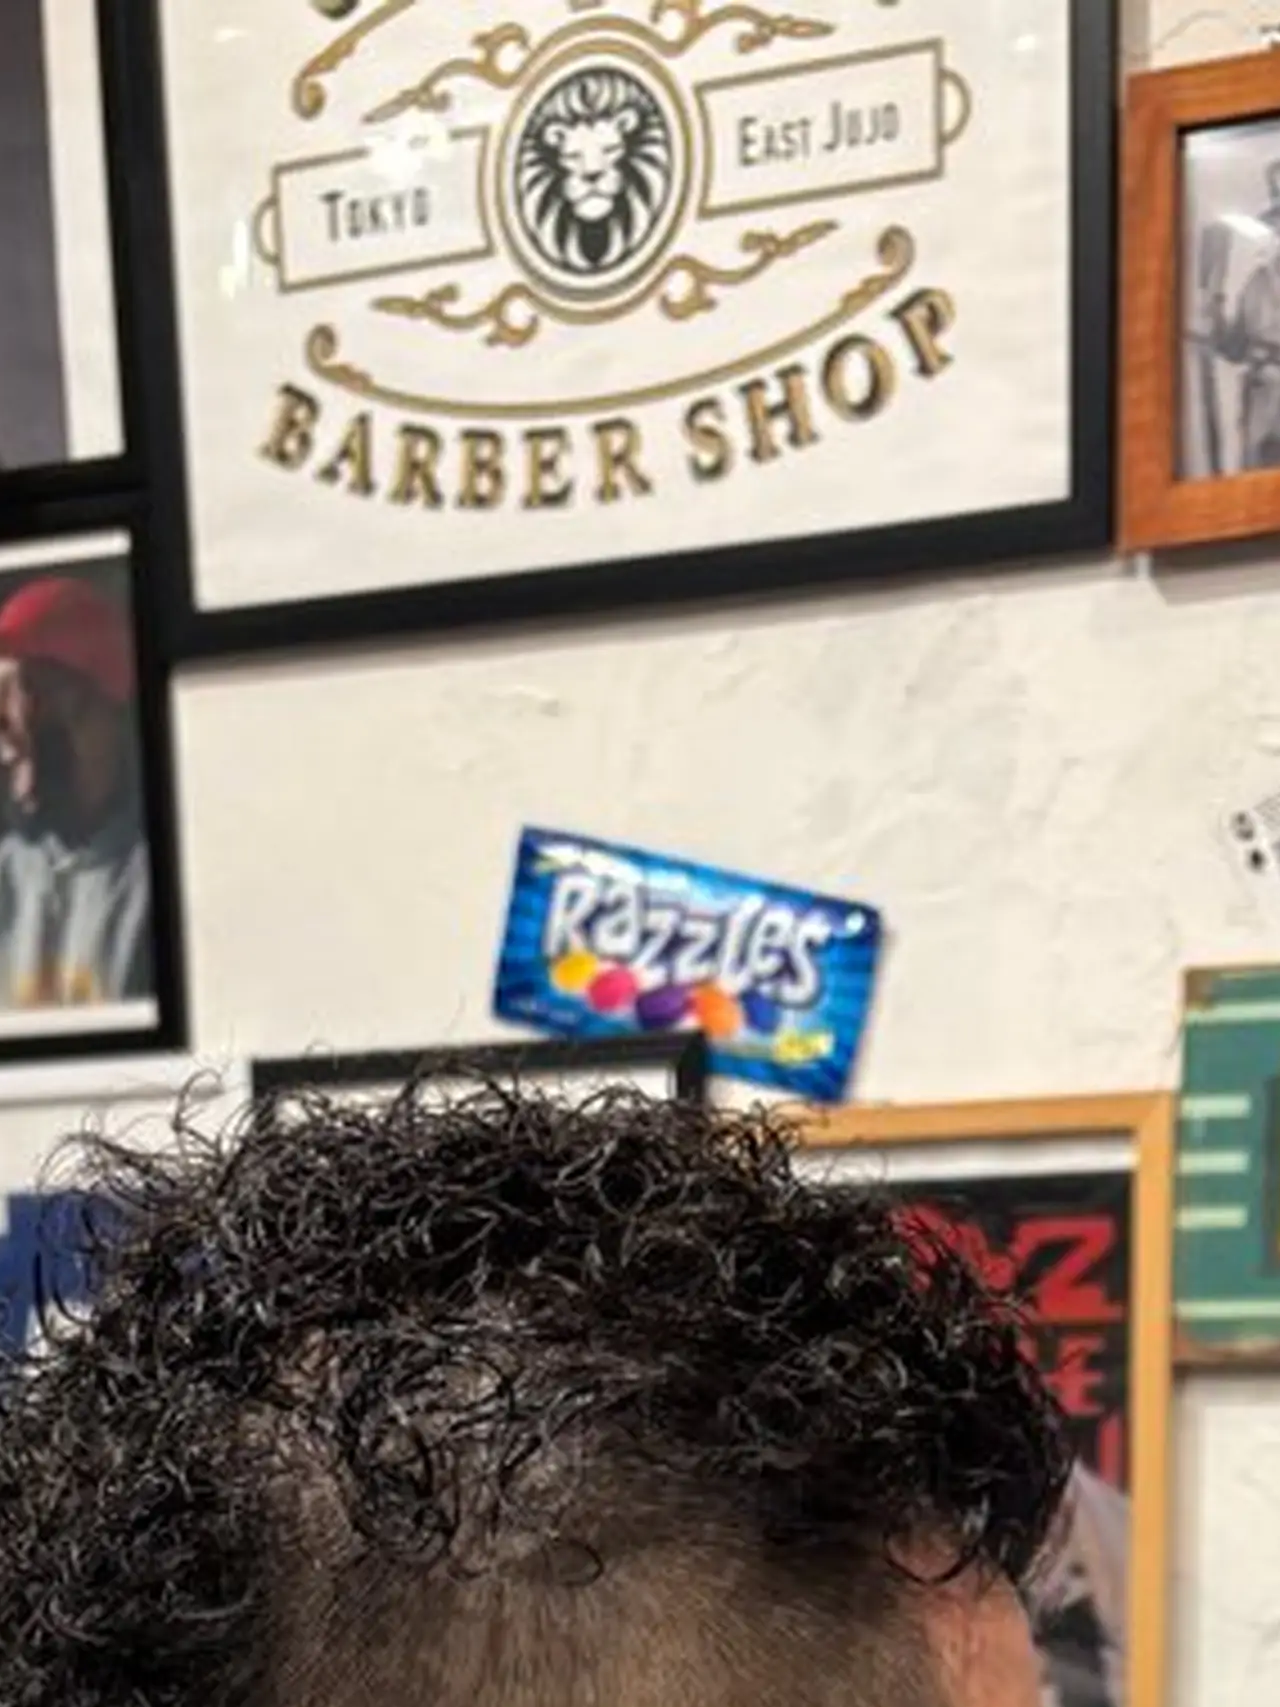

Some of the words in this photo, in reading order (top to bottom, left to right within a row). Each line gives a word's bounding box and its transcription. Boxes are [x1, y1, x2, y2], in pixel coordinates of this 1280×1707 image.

[738, 114, 812, 169] EAST
[822, 98, 900, 152] JUJO
[319, 185, 430, 242] TOKYO
[260, 382, 654, 512] BARBER
[682, 286, 958, 484] SHOP
[546, 872, 832, 1004] Razzles
